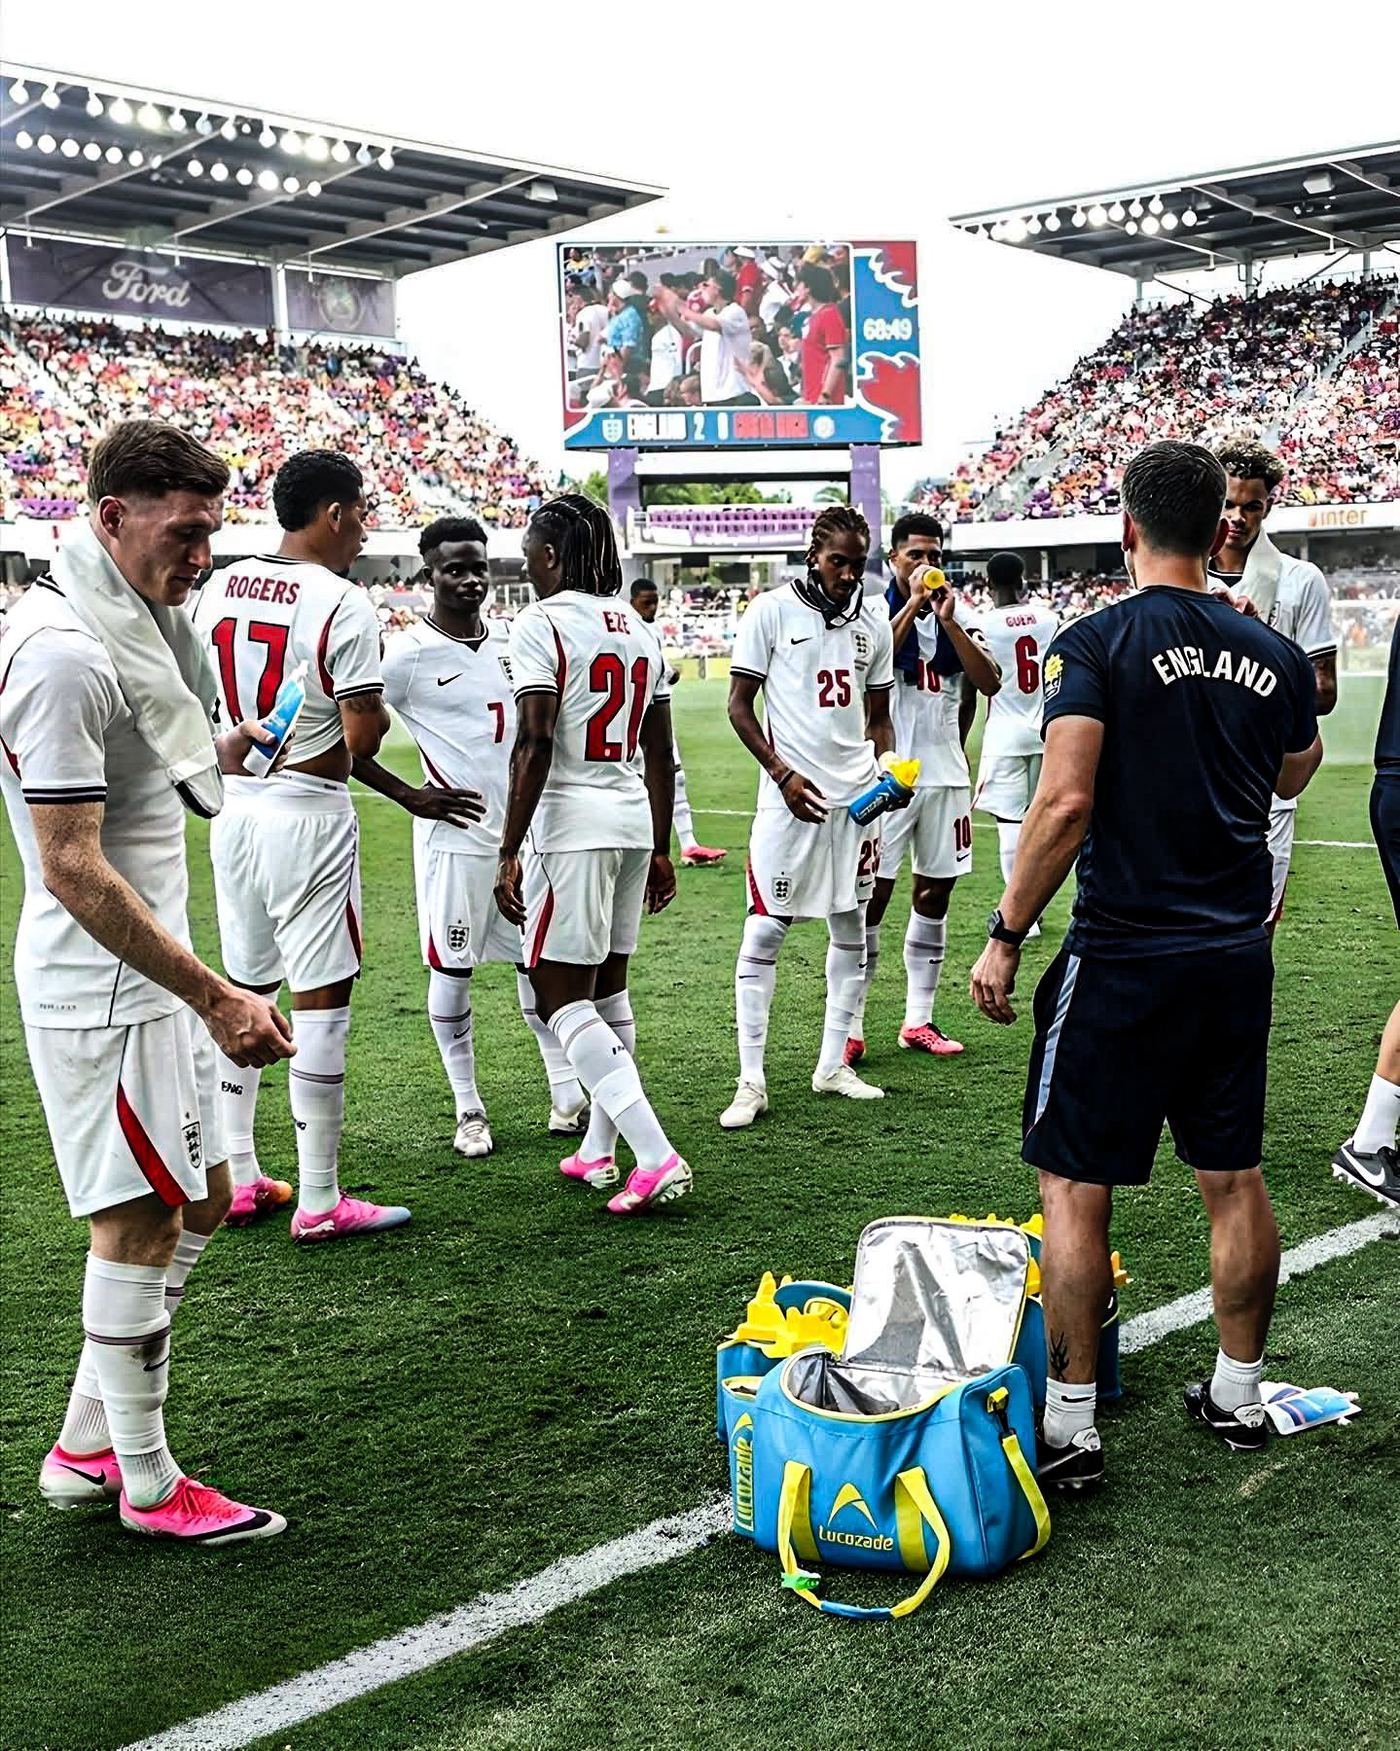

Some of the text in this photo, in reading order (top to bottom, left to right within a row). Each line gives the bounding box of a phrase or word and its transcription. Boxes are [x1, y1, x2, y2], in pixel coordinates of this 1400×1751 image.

[102, 261, 191, 307] Ford
[863, 318, 912, 341] 68:49
[693, 412, 705, 441] 2
[1320, 509, 1368, 526] inter
[225, 575, 300, 604] ROGERS
[603, 611, 630, 634] EZE
[211, 616, 290, 727] 17
[1015, 635, 1039, 694] 6
[1152, 646, 1277, 697] ENGLAND
[817, 669, 851, 707] 25
[487, 702, 505, 743] 7
[584, 653, 649, 762] 21
[954, 815, 972, 852] 10
[818, 1525, 893, 1551] Lucozade
